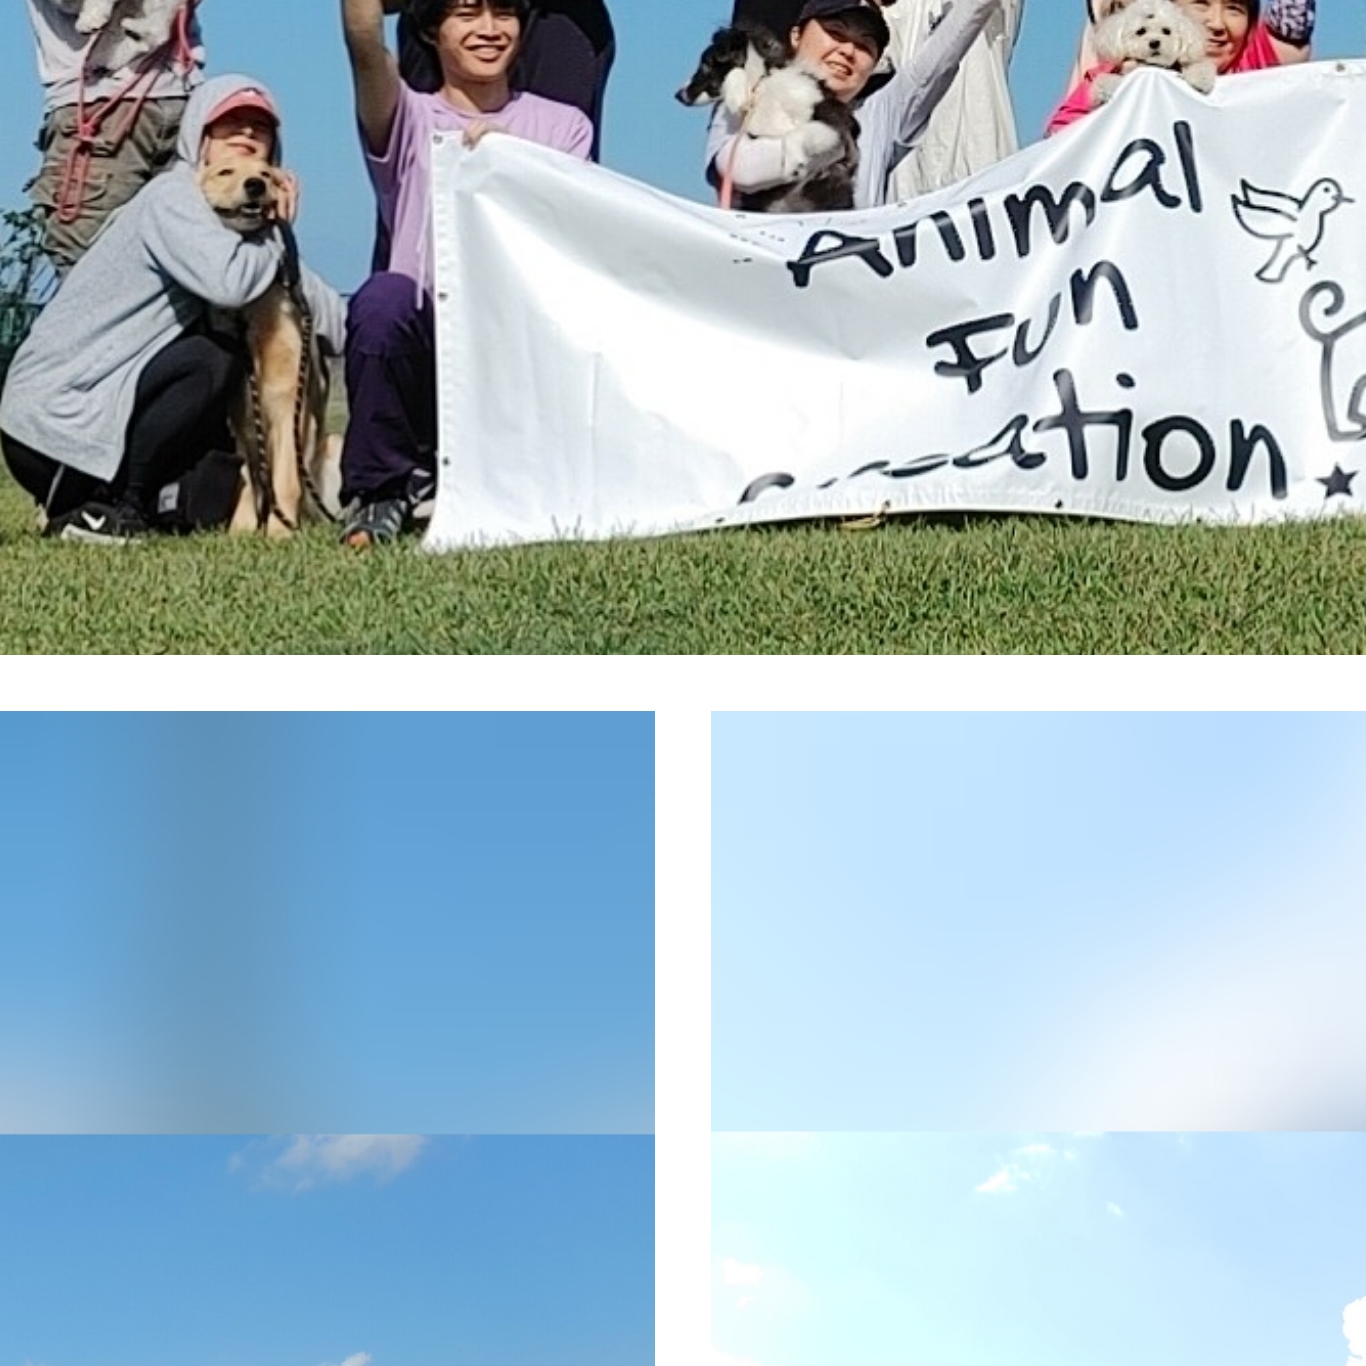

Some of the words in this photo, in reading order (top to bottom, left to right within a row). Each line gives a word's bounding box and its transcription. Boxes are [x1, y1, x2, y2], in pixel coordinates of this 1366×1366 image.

[786, 119, 1204, 287] Animal
[925, 260, 1138, 394] Fun
[738, 368, 1289, 503] ation
